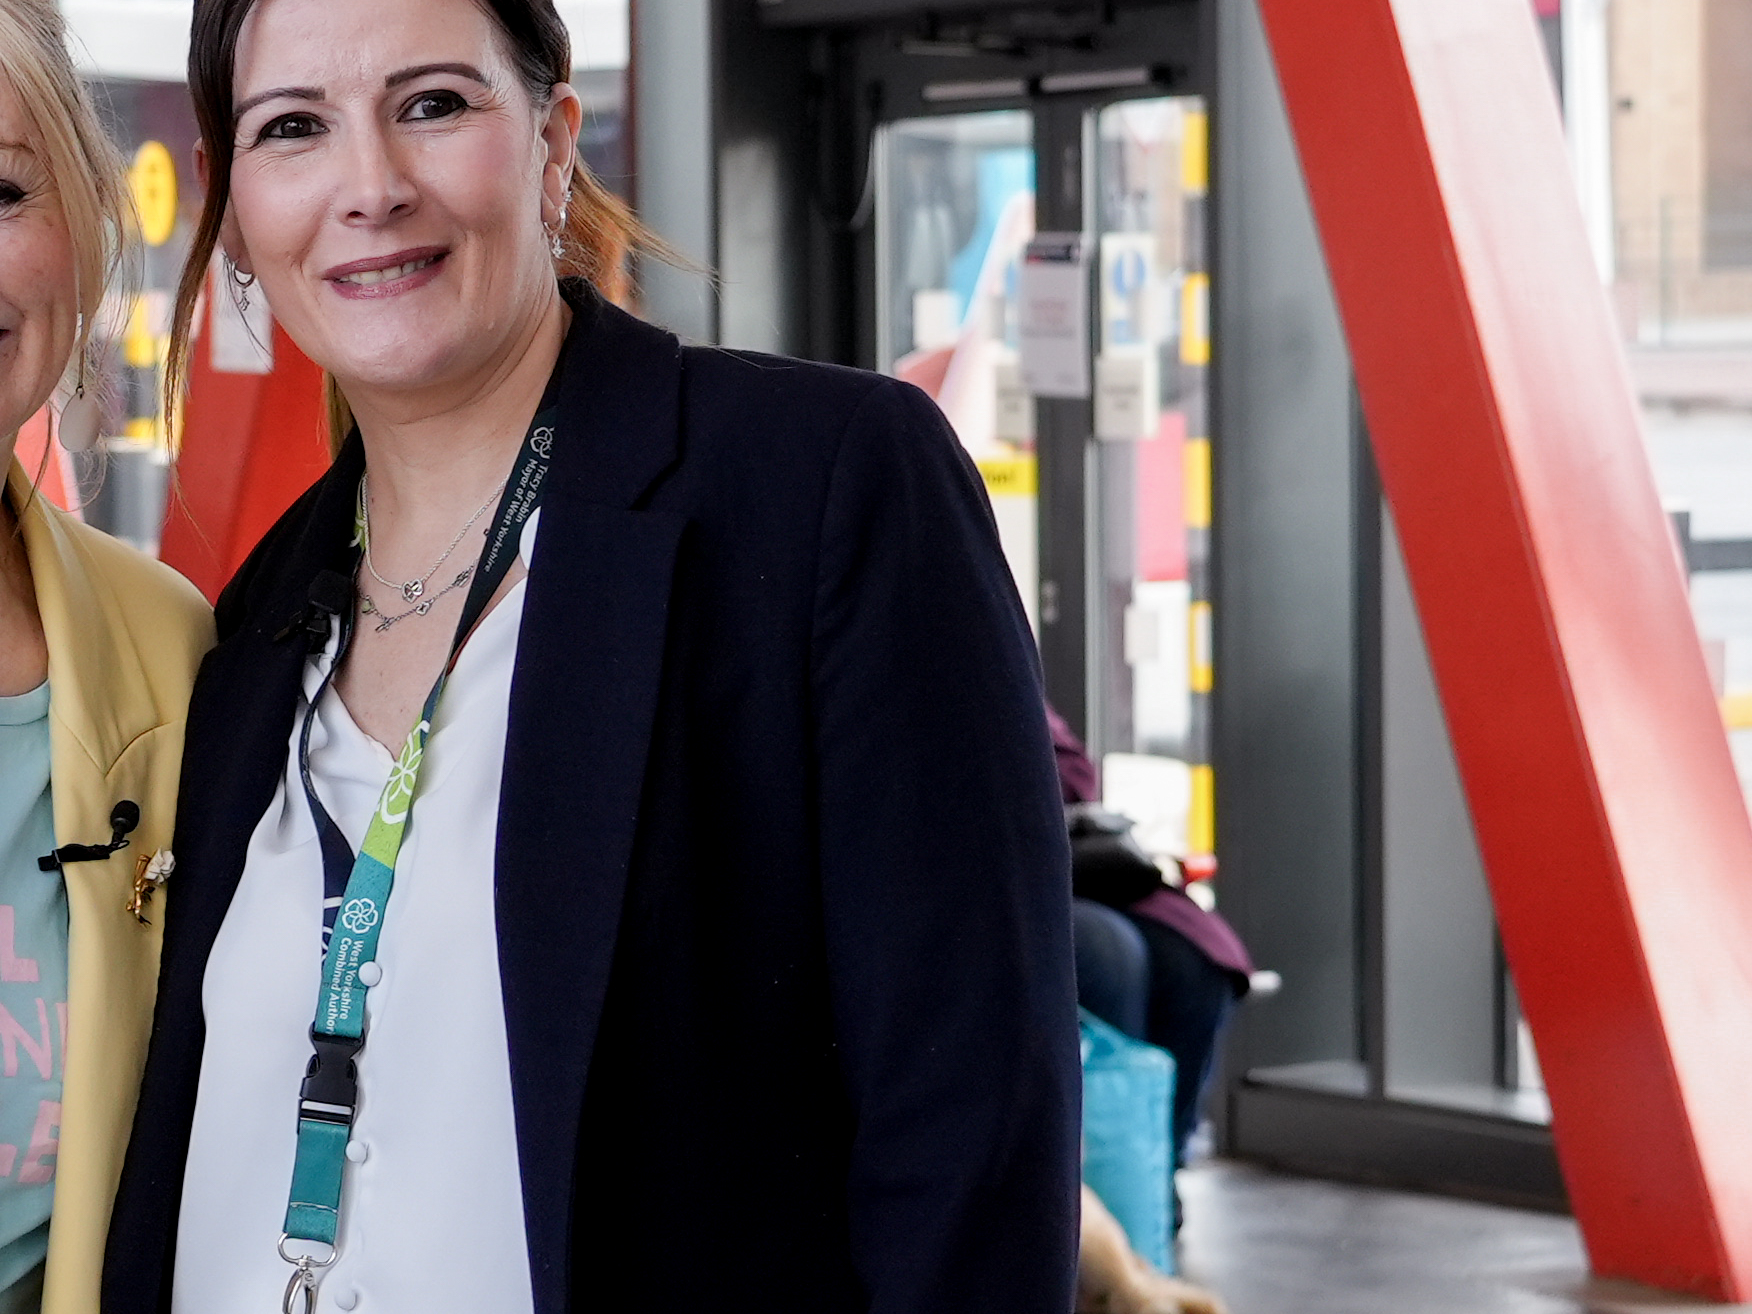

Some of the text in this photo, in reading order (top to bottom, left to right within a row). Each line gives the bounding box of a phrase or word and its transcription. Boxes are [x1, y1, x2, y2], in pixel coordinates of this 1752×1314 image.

[484, 458, 538, 573] Mayor of West Yorkshire
[515, 465, 549, 523] Tracy Brabin
[330, 938, 351, 991] Combined
[339, 940, 364, 1020] West Yorkshire
